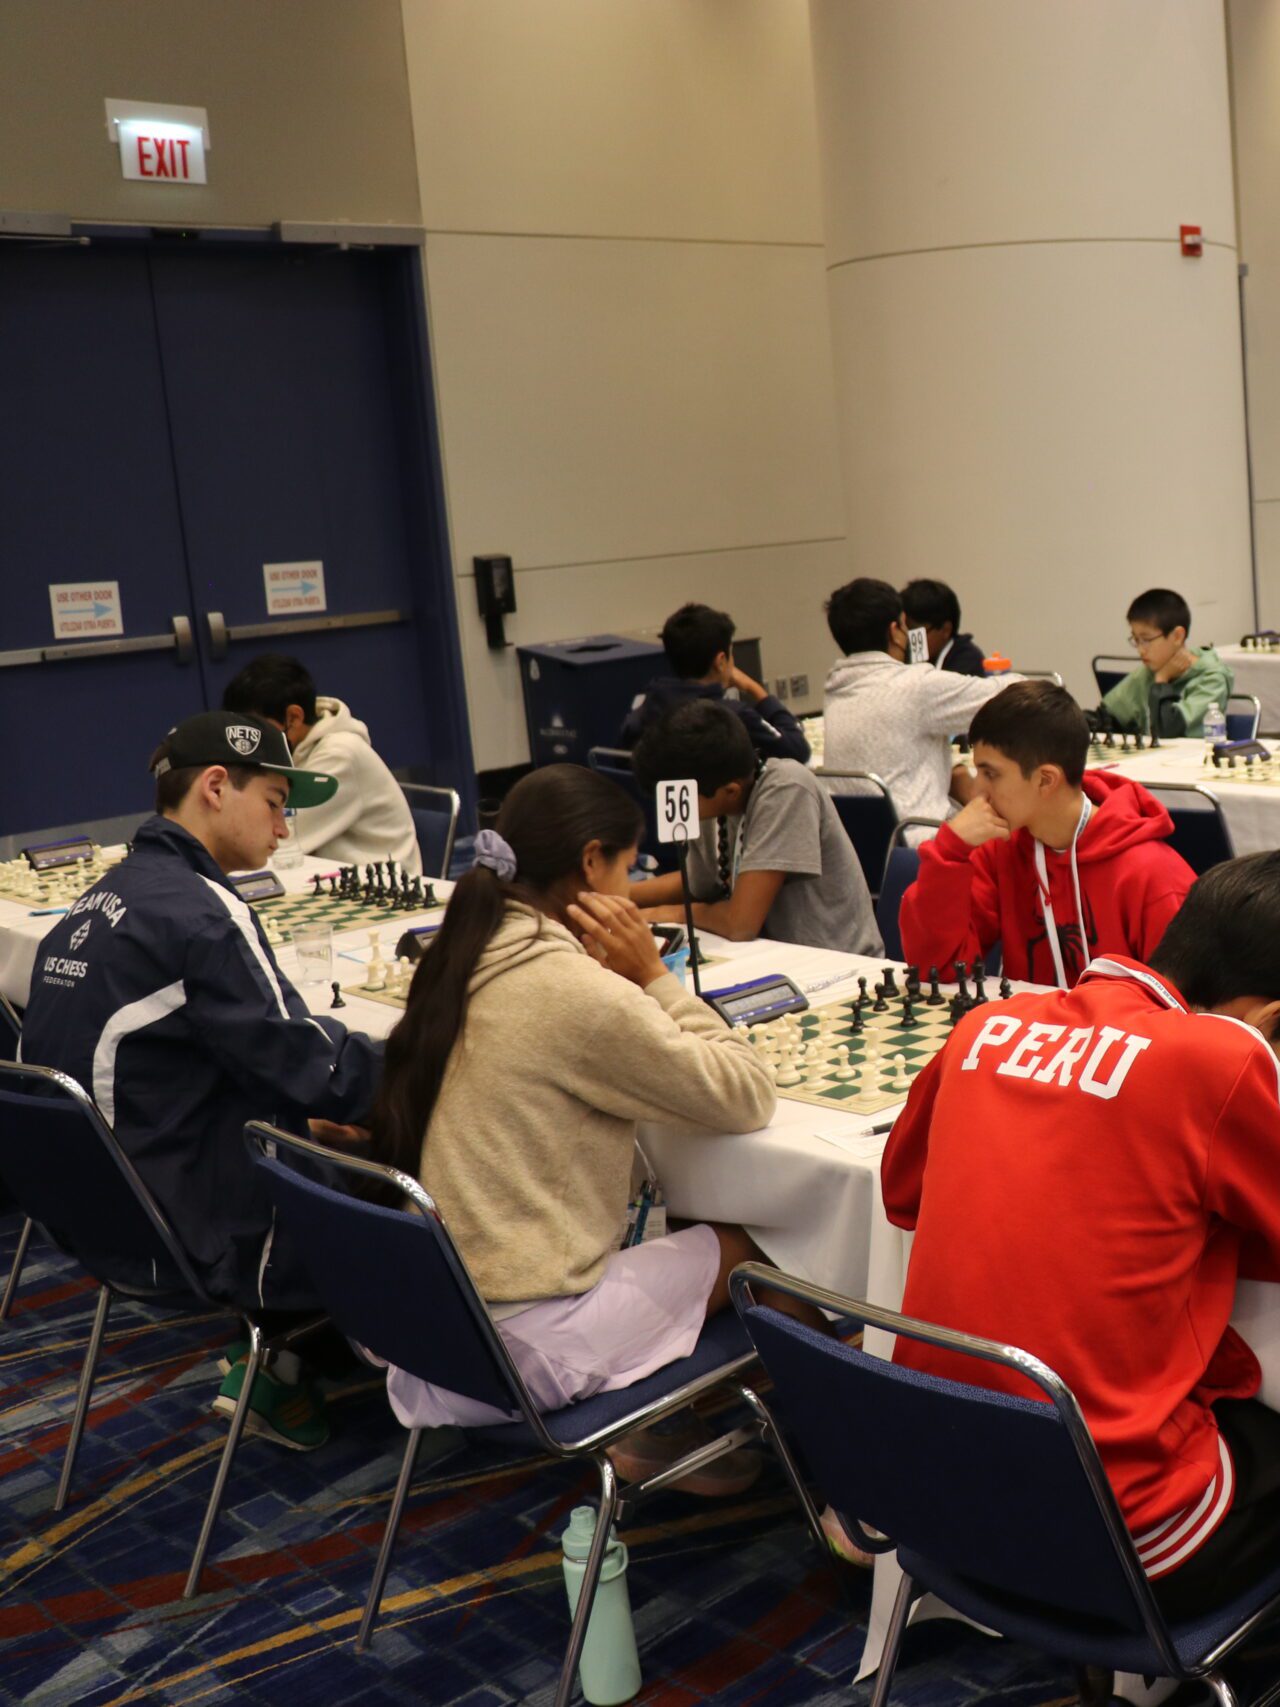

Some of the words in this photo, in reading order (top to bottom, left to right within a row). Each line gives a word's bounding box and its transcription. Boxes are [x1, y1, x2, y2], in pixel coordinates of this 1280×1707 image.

[137, 136, 190, 179] EXIT
[911, 631, 924, 652] 99
[229, 726, 259, 742] NETS
[665, 785, 690, 823] 56
[65, 892, 108, 920] TEAM
[102, 892, 127, 928] USA
[44, 956, 58, 972] US
[55, 958, 89, 978] CHESS
[961, 1015, 1152, 1099] PERU
